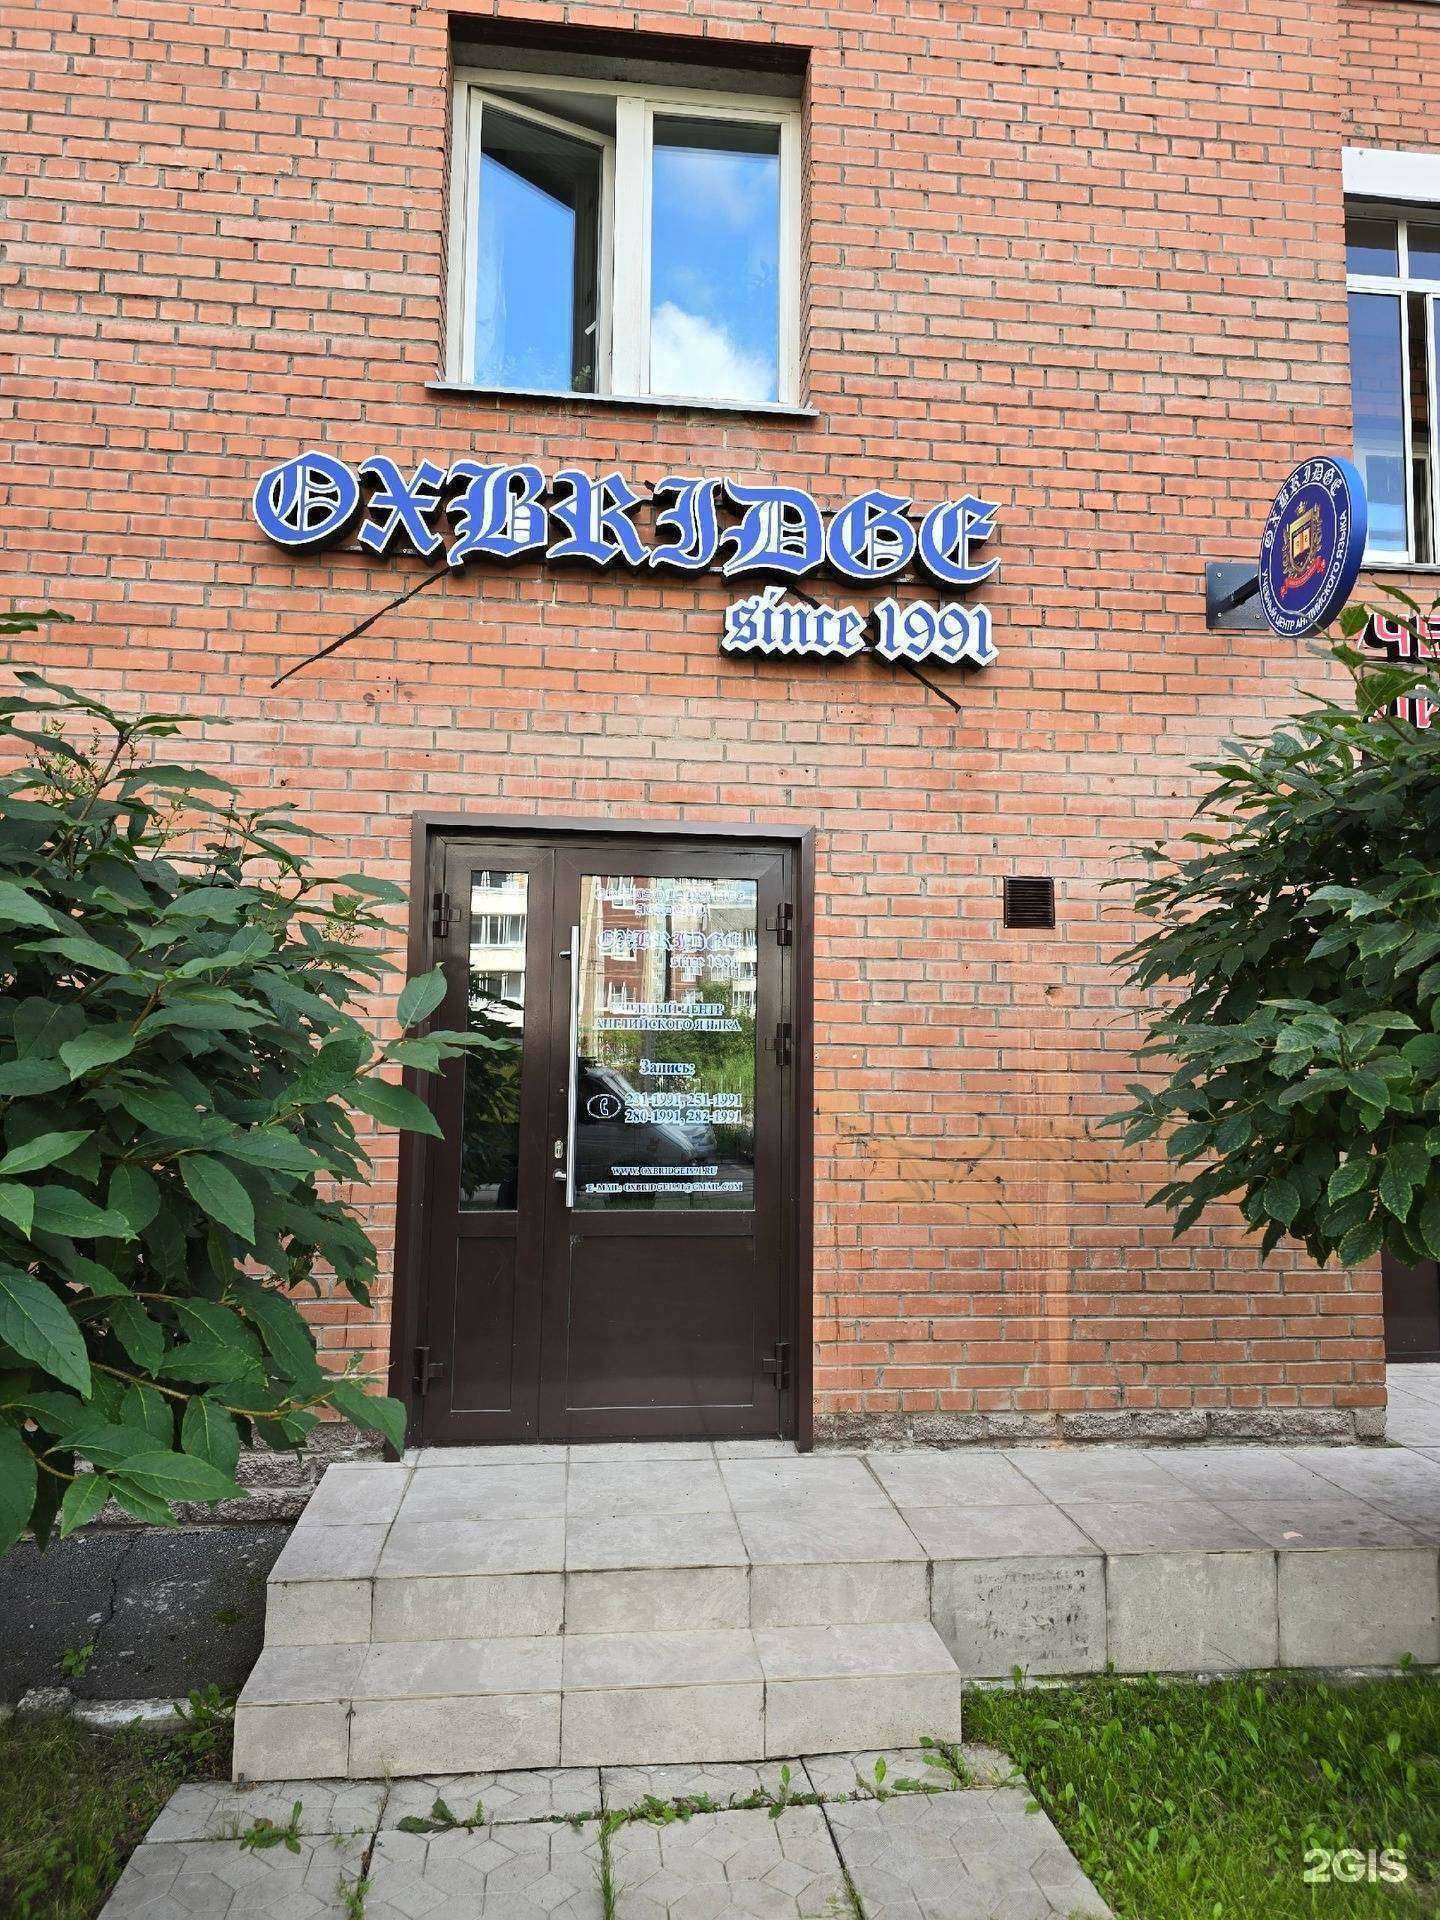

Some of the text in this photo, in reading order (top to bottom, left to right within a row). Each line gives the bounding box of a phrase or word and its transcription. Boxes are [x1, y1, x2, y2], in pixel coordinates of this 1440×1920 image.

[252, 450, 1002, 586] OXBRIDGE
[1264, 463, 1343, 548] OXBRIDGE
[1275, 614, 1296, 631] ЦЕНТР
[1335, 509, 1348, 559] ЯЗЫКА
[723, 586, 1000, 668] since 1991
[639, 1059, 695, 1076] Запись:
[687, 1093, 742, 1107] 251-1991
[686, 1110, 742, 1124] 282-1991
